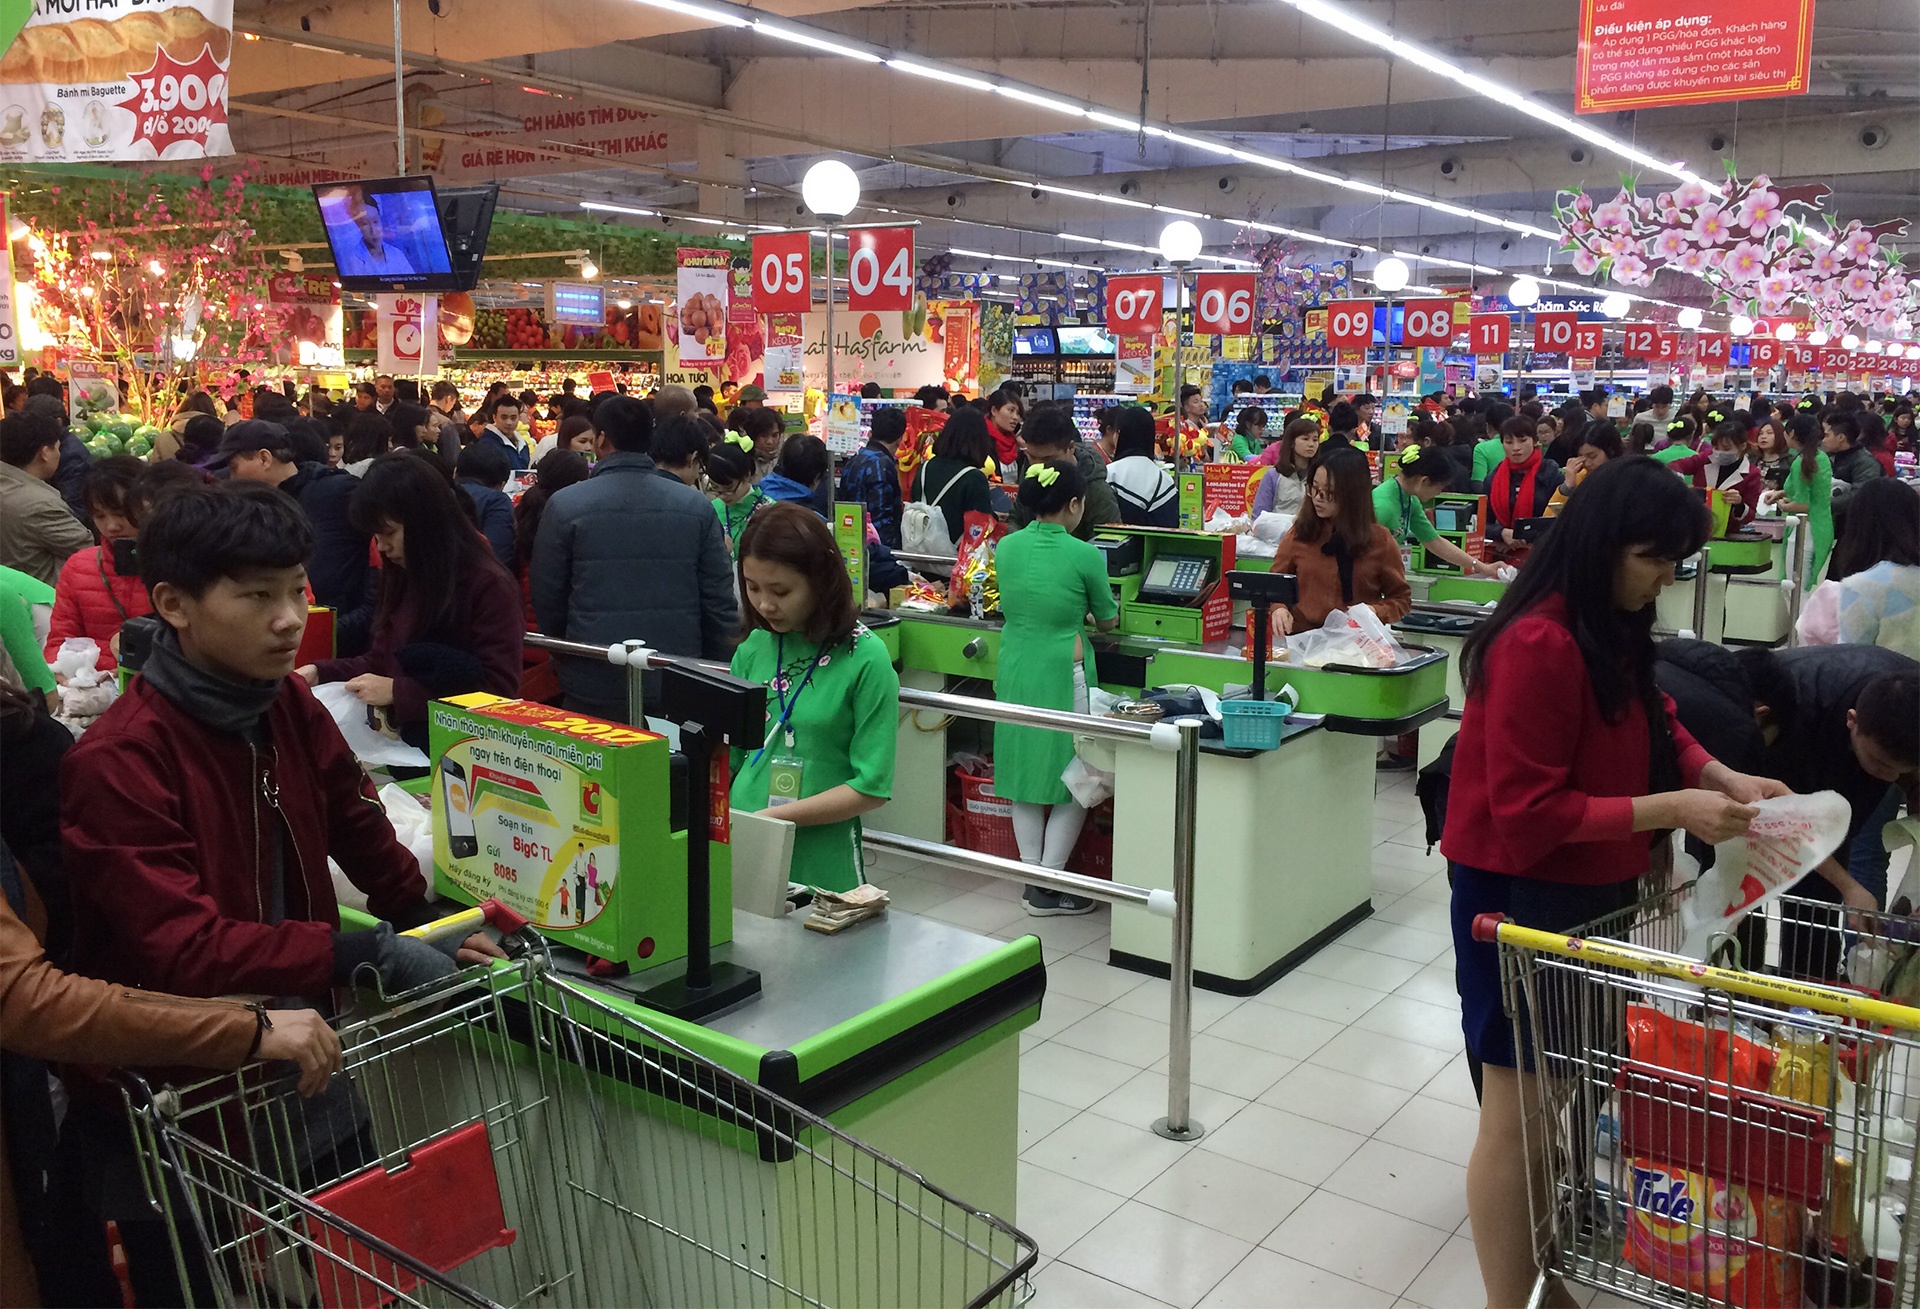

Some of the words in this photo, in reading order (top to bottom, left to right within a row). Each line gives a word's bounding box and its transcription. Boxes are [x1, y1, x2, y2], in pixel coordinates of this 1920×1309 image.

[1603, 36, 1616, 47] Áp
[1619, 33, 1644, 45] dụng
[1726, 23, 1758, 33] Khách
[1761, 21, 1787, 30] hàng
[1626, 20, 1652, 33] kiện
[1655, 18, 1671, 30] áp
[1675, 15, 1712, 28] dụng:
[1593, 51, 1604, 60] có
[1638, 45, 1663, 55] dụng
[1695, 39, 1718, 49] PGG
[1721, 37, 1745, 46] khác
[1748, 33, 1766, 44] loại
[1592, 63, 1618, 71] trong
[1620, 59, 1639, 68] một
[1659, 56, 1680, 65] mua
[1706, 50, 1731, 61] (một
[1734, 48, 1753, 57] hóa
[1756, 45, 1780, 55] đơn)
[1601, 73, 1621, 82] PGG
[1625, 70, 1654, 80] không
[1657, 69, 1669, 78] áp
[1672, 66, 1698, 75] dụng
[1700, 63, 1719, 73] cho
[1722, 62, 1740, 70] các
[1620, 83, 1644, 92] đang
[1734, 72, 1747, 82] tại
[1749, 71, 1769, 80] siêu
[1773, 69, 1786, 78] thị
[57, 87, 79, 98] Bánh
[91, 85, 126, 98] Baguette
[545, 110, 585, 130] HÀNG
[588, 105, 613, 124] TÌM
[462, 149, 482, 168] GIÁ
[625, 131, 668, 153] KHÁC
[761, 253, 804, 294] 05
[851, 247, 912, 296] 04
[1115, 290, 1156, 320] 07
[1200, 289, 1251, 324] 06
[1567, 300, 1590, 312] Sóc
[1333, 312, 1368, 337] 09
[1407, 310, 1450, 337] 08
[1481, 324, 1499, 344] 11
[1541, 321, 1572, 344] 10
[835, 329, 927, 361] Hasfarm
[1576, 332, 1596, 350] 13
[1628, 331, 1652, 351] 12
[1660, 340, 1671, 356] 5
[1699, 339, 1723, 357] 14
[1752, 344, 1772, 360] 16
[1796, 350, 1813, 364] 18
[1827, 354, 1848, 367] 20
[1857, 357, 1876, 368] 22
[1849, 360, 1856, 370] 2
[1879, 359, 1897, 371] 24
[1901, 362, 1918, 372] 26
[666, 373, 685, 384] HOA
[435, 710, 458, 731] Nhận
[459, 717, 485, 739] thông
[485, 723, 500, 740] tin
[537, 742, 556, 757] mãi
[586, 752, 603, 770] phí
[540, 717, 658, 742] 2017
[469, 745, 490, 766] ngay
[493, 750, 511, 766] trên
[515, 755, 534, 774] điện
[537, 760, 562, 782] thoại
[498, 814, 519, 831] Soạn
[521, 822, 533, 835] tin
[513, 837, 538, 858] BigC
[541, 845, 553, 863] TL
[463, 869, 480, 883] đăng
[483, 875, 492, 887] ký
[493, 862, 518, 883] 8085
[1629, 1165, 1695, 1221] Tide
